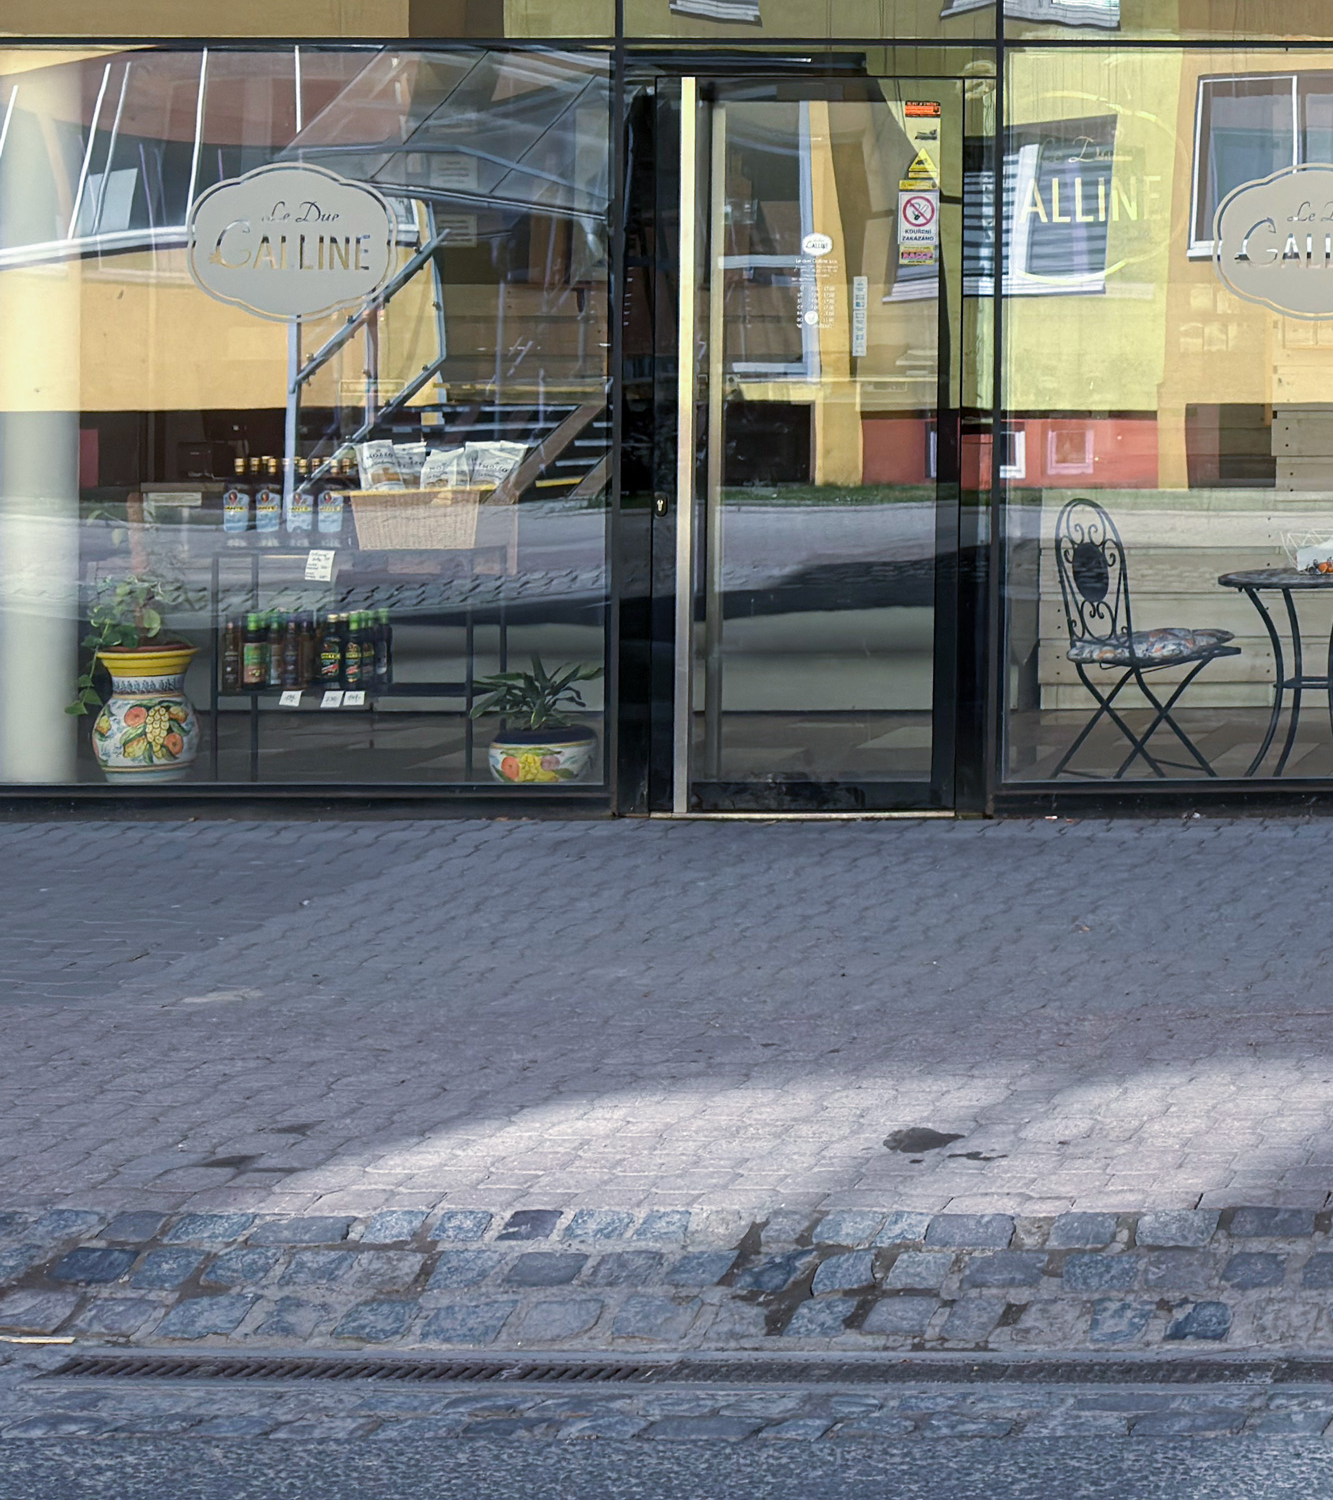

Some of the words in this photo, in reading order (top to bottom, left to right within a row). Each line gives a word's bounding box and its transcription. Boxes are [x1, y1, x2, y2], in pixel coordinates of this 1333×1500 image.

[261, 201, 291, 222] Le
[295, 201, 340, 222] Due
[1019, 175, 1166, 223] ALLINE
[1286, 201, 1316, 222] Le
[208, 218, 371, 271] GALLINE
